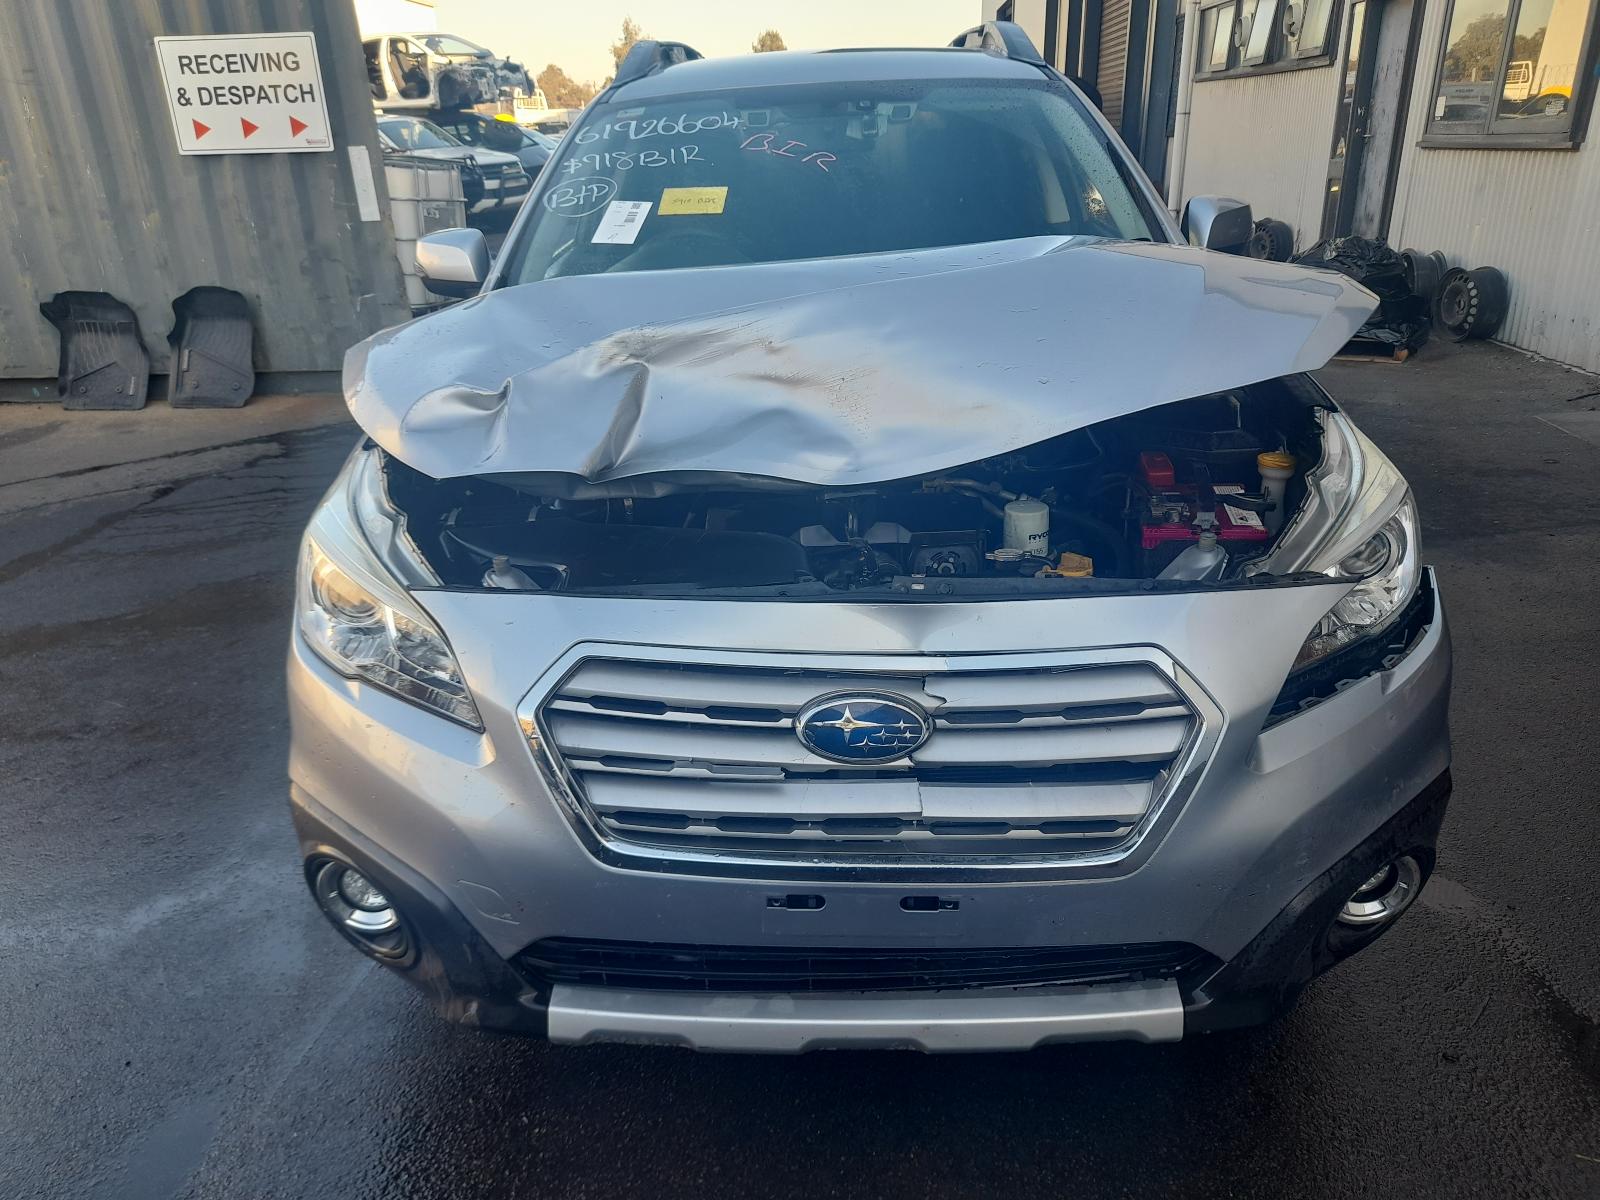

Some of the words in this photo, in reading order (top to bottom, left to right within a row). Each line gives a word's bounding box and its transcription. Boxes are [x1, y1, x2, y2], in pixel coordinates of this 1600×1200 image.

[178, 51, 301, 75] RECEIVING
[177, 87, 193, 107] &
[197, 83, 316, 106] DESPATCH
[574, 111, 744, 145] 61926604
